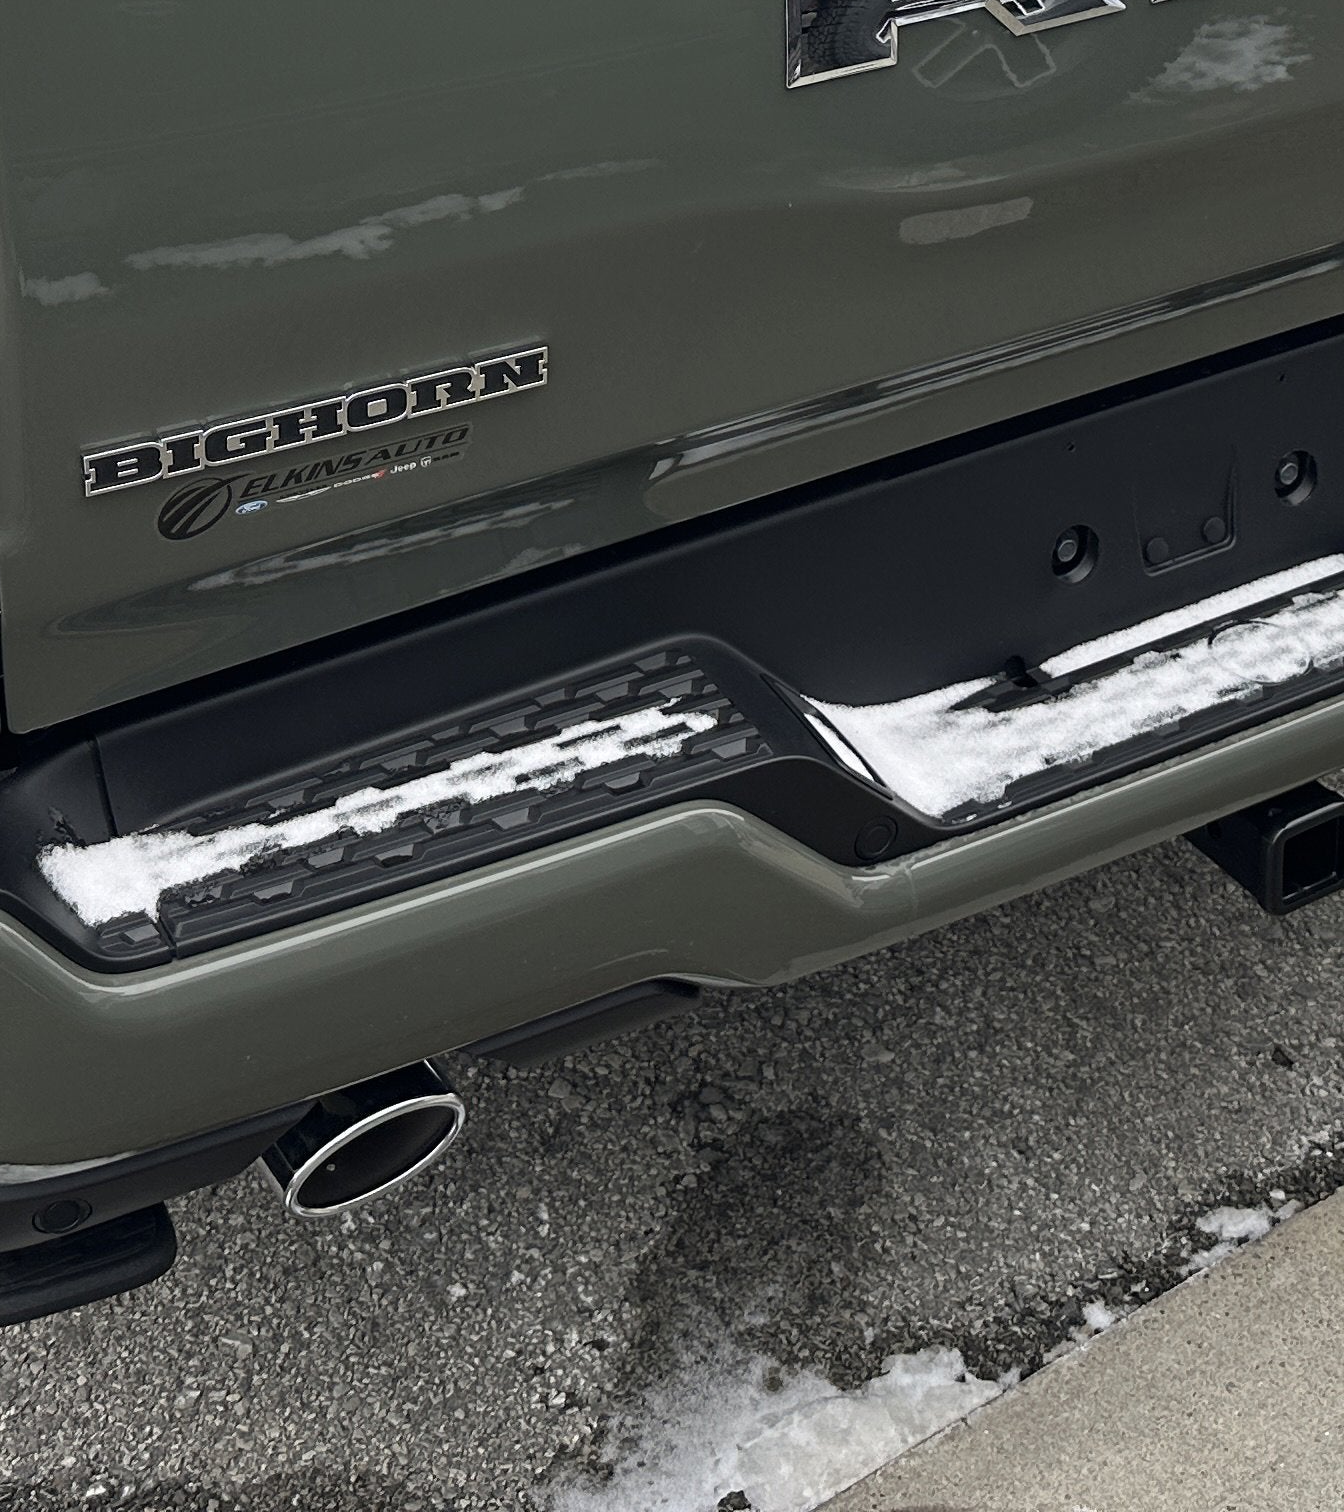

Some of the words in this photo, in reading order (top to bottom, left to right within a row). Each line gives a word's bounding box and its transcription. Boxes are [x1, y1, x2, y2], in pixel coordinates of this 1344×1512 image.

[82, 345, 548, 498] BIGHORN
[239, 449, 368, 500] ELKINS
[363, 426, 471, 466] AUTO
[389, 461, 417, 475] Jeep
